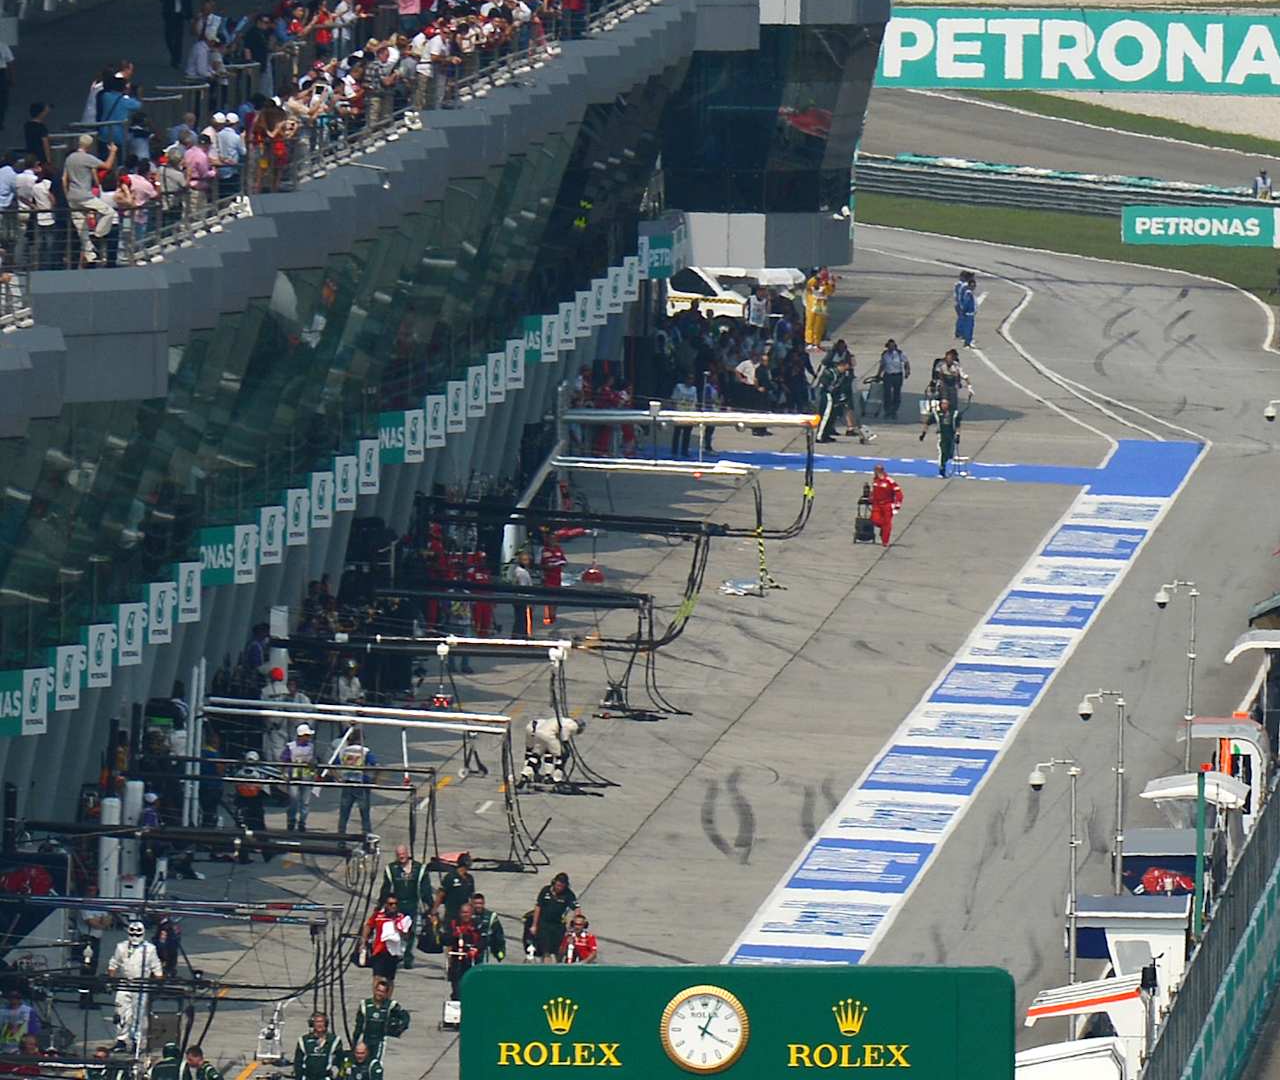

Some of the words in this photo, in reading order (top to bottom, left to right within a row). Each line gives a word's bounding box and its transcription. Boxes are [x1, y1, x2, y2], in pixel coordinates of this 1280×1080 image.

[1135, 216, 1261, 238] PETRONAS
[497, 1042, 622, 1067] ROLEX
[787, 1043, 911, 1068] ROLEX
